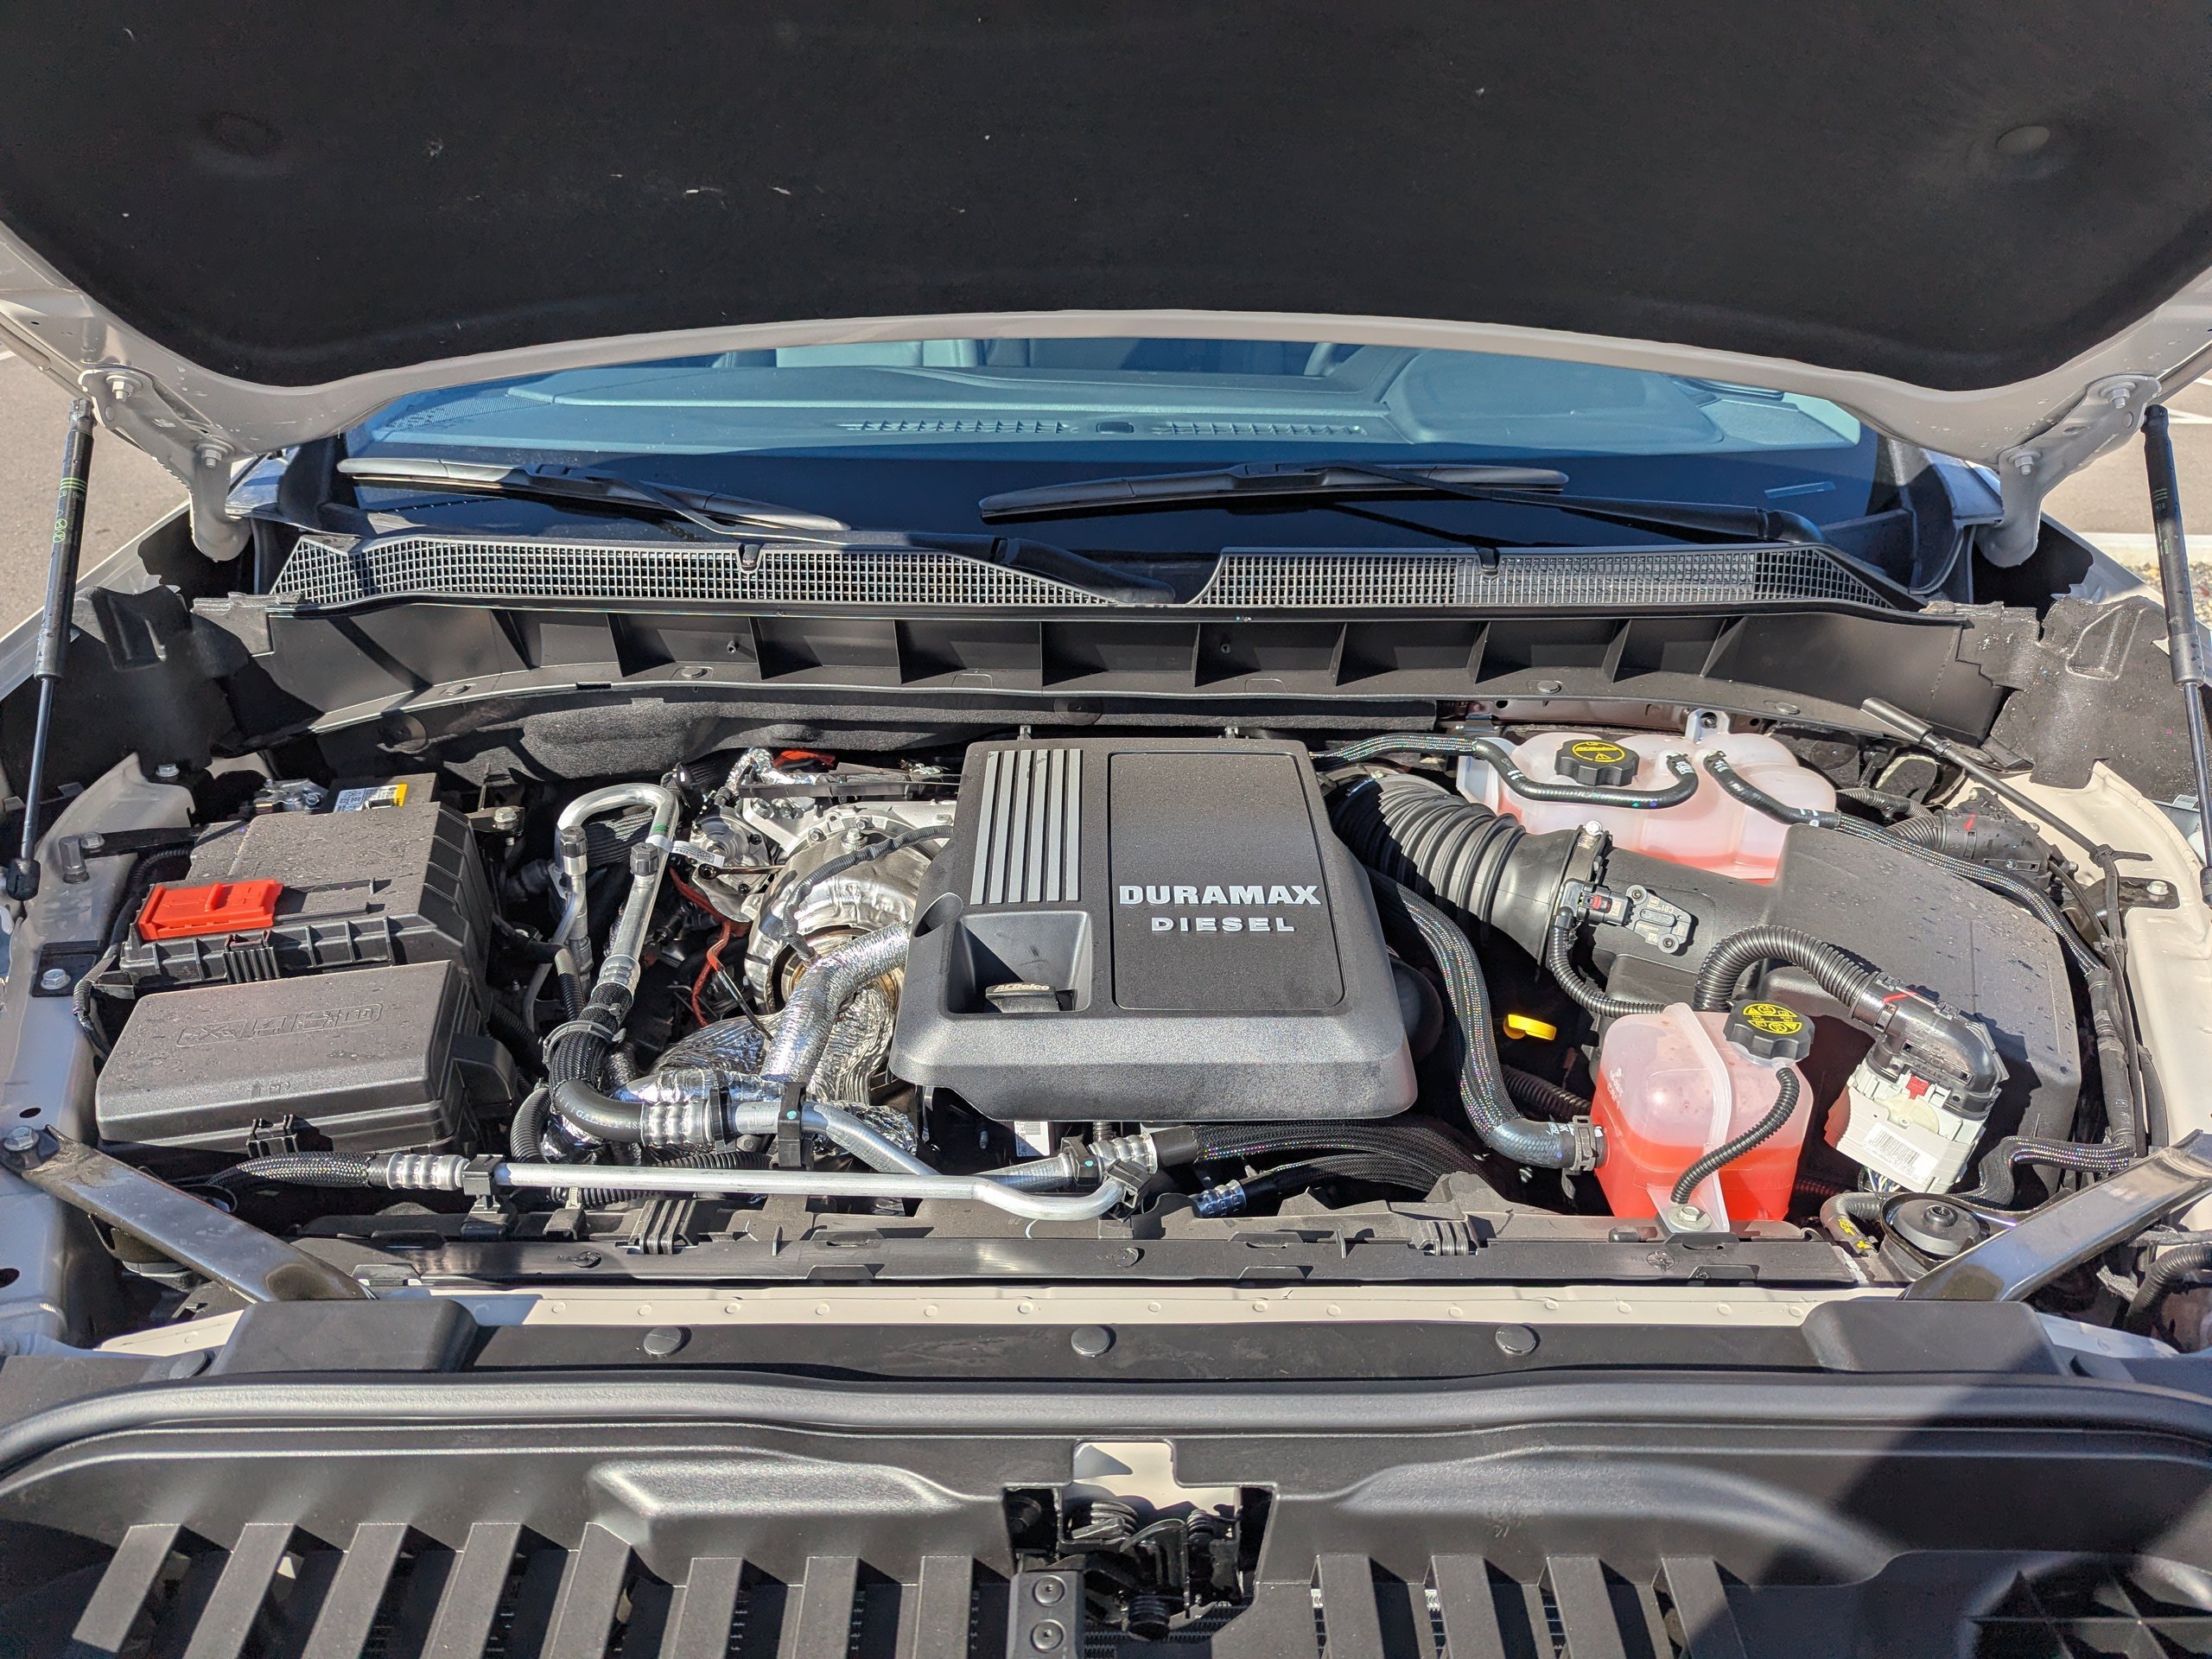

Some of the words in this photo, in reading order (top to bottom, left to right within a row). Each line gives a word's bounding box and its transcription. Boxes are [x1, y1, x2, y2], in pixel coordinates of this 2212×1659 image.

[1119, 885, 1322, 906] DURAMAX
[1151, 917, 1295, 932] DIESEL
[993, 983, 1051, 993] ACDelco
